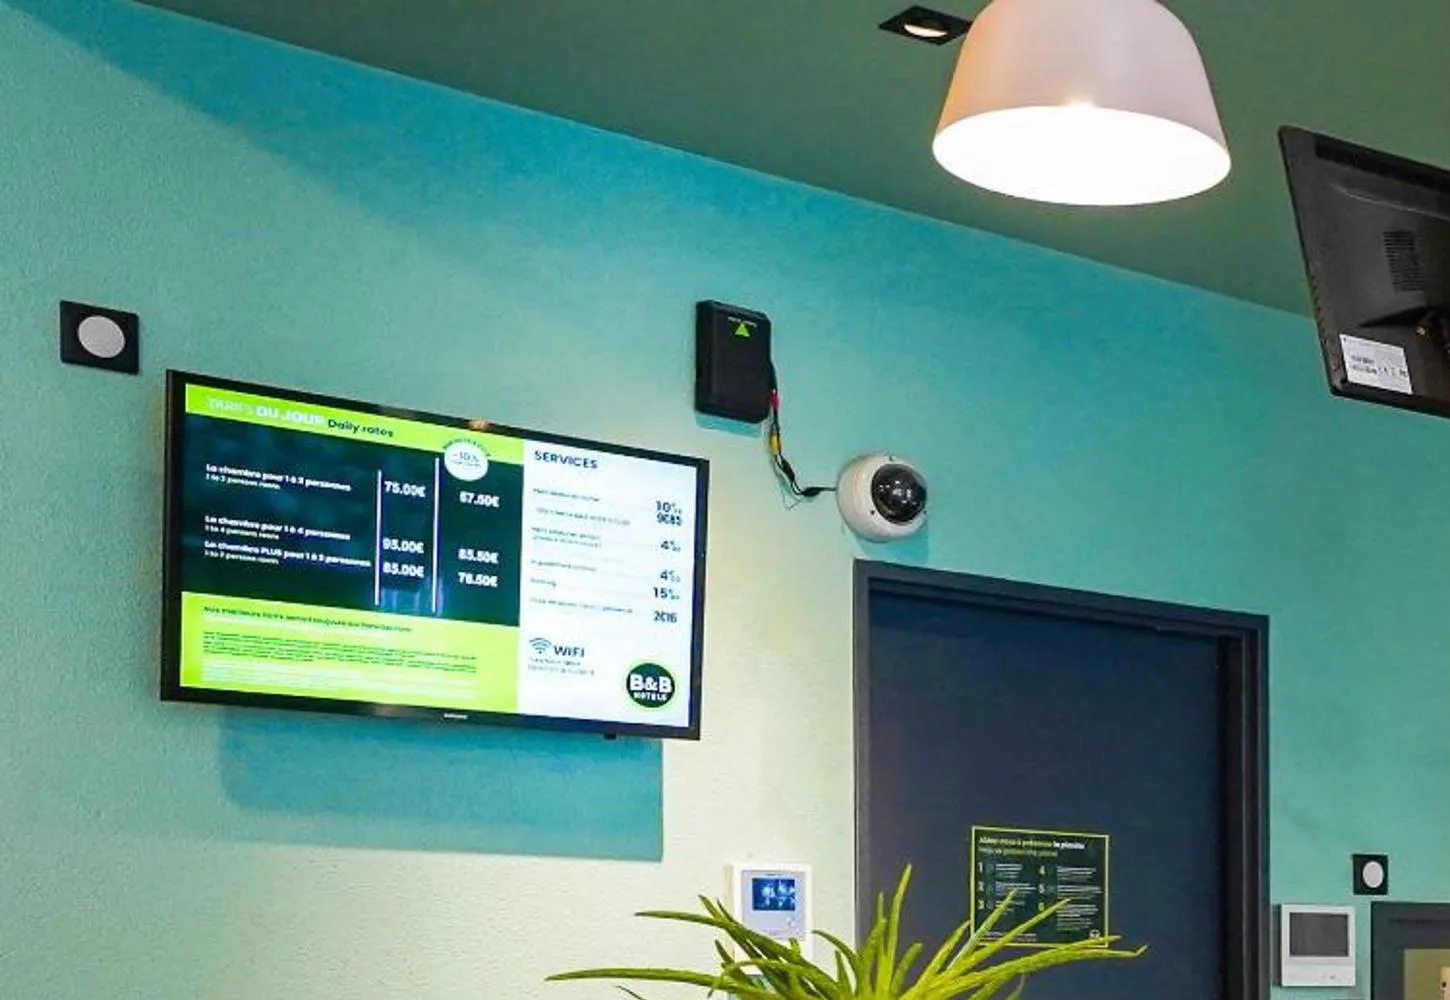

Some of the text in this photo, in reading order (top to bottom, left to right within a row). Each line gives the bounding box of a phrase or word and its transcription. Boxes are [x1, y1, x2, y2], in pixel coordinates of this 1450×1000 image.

[328, 418, 359, 435] Daily
[361, 425, 394, 439] rates
[534, 450, 599, 470] SERVICES
[384, 480, 426, 498] 75.00€
[383, 561, 425, 578] 85.00€
[629, 673, 673, 693] B&B
[633, 690, 668, 702] HOTELS
